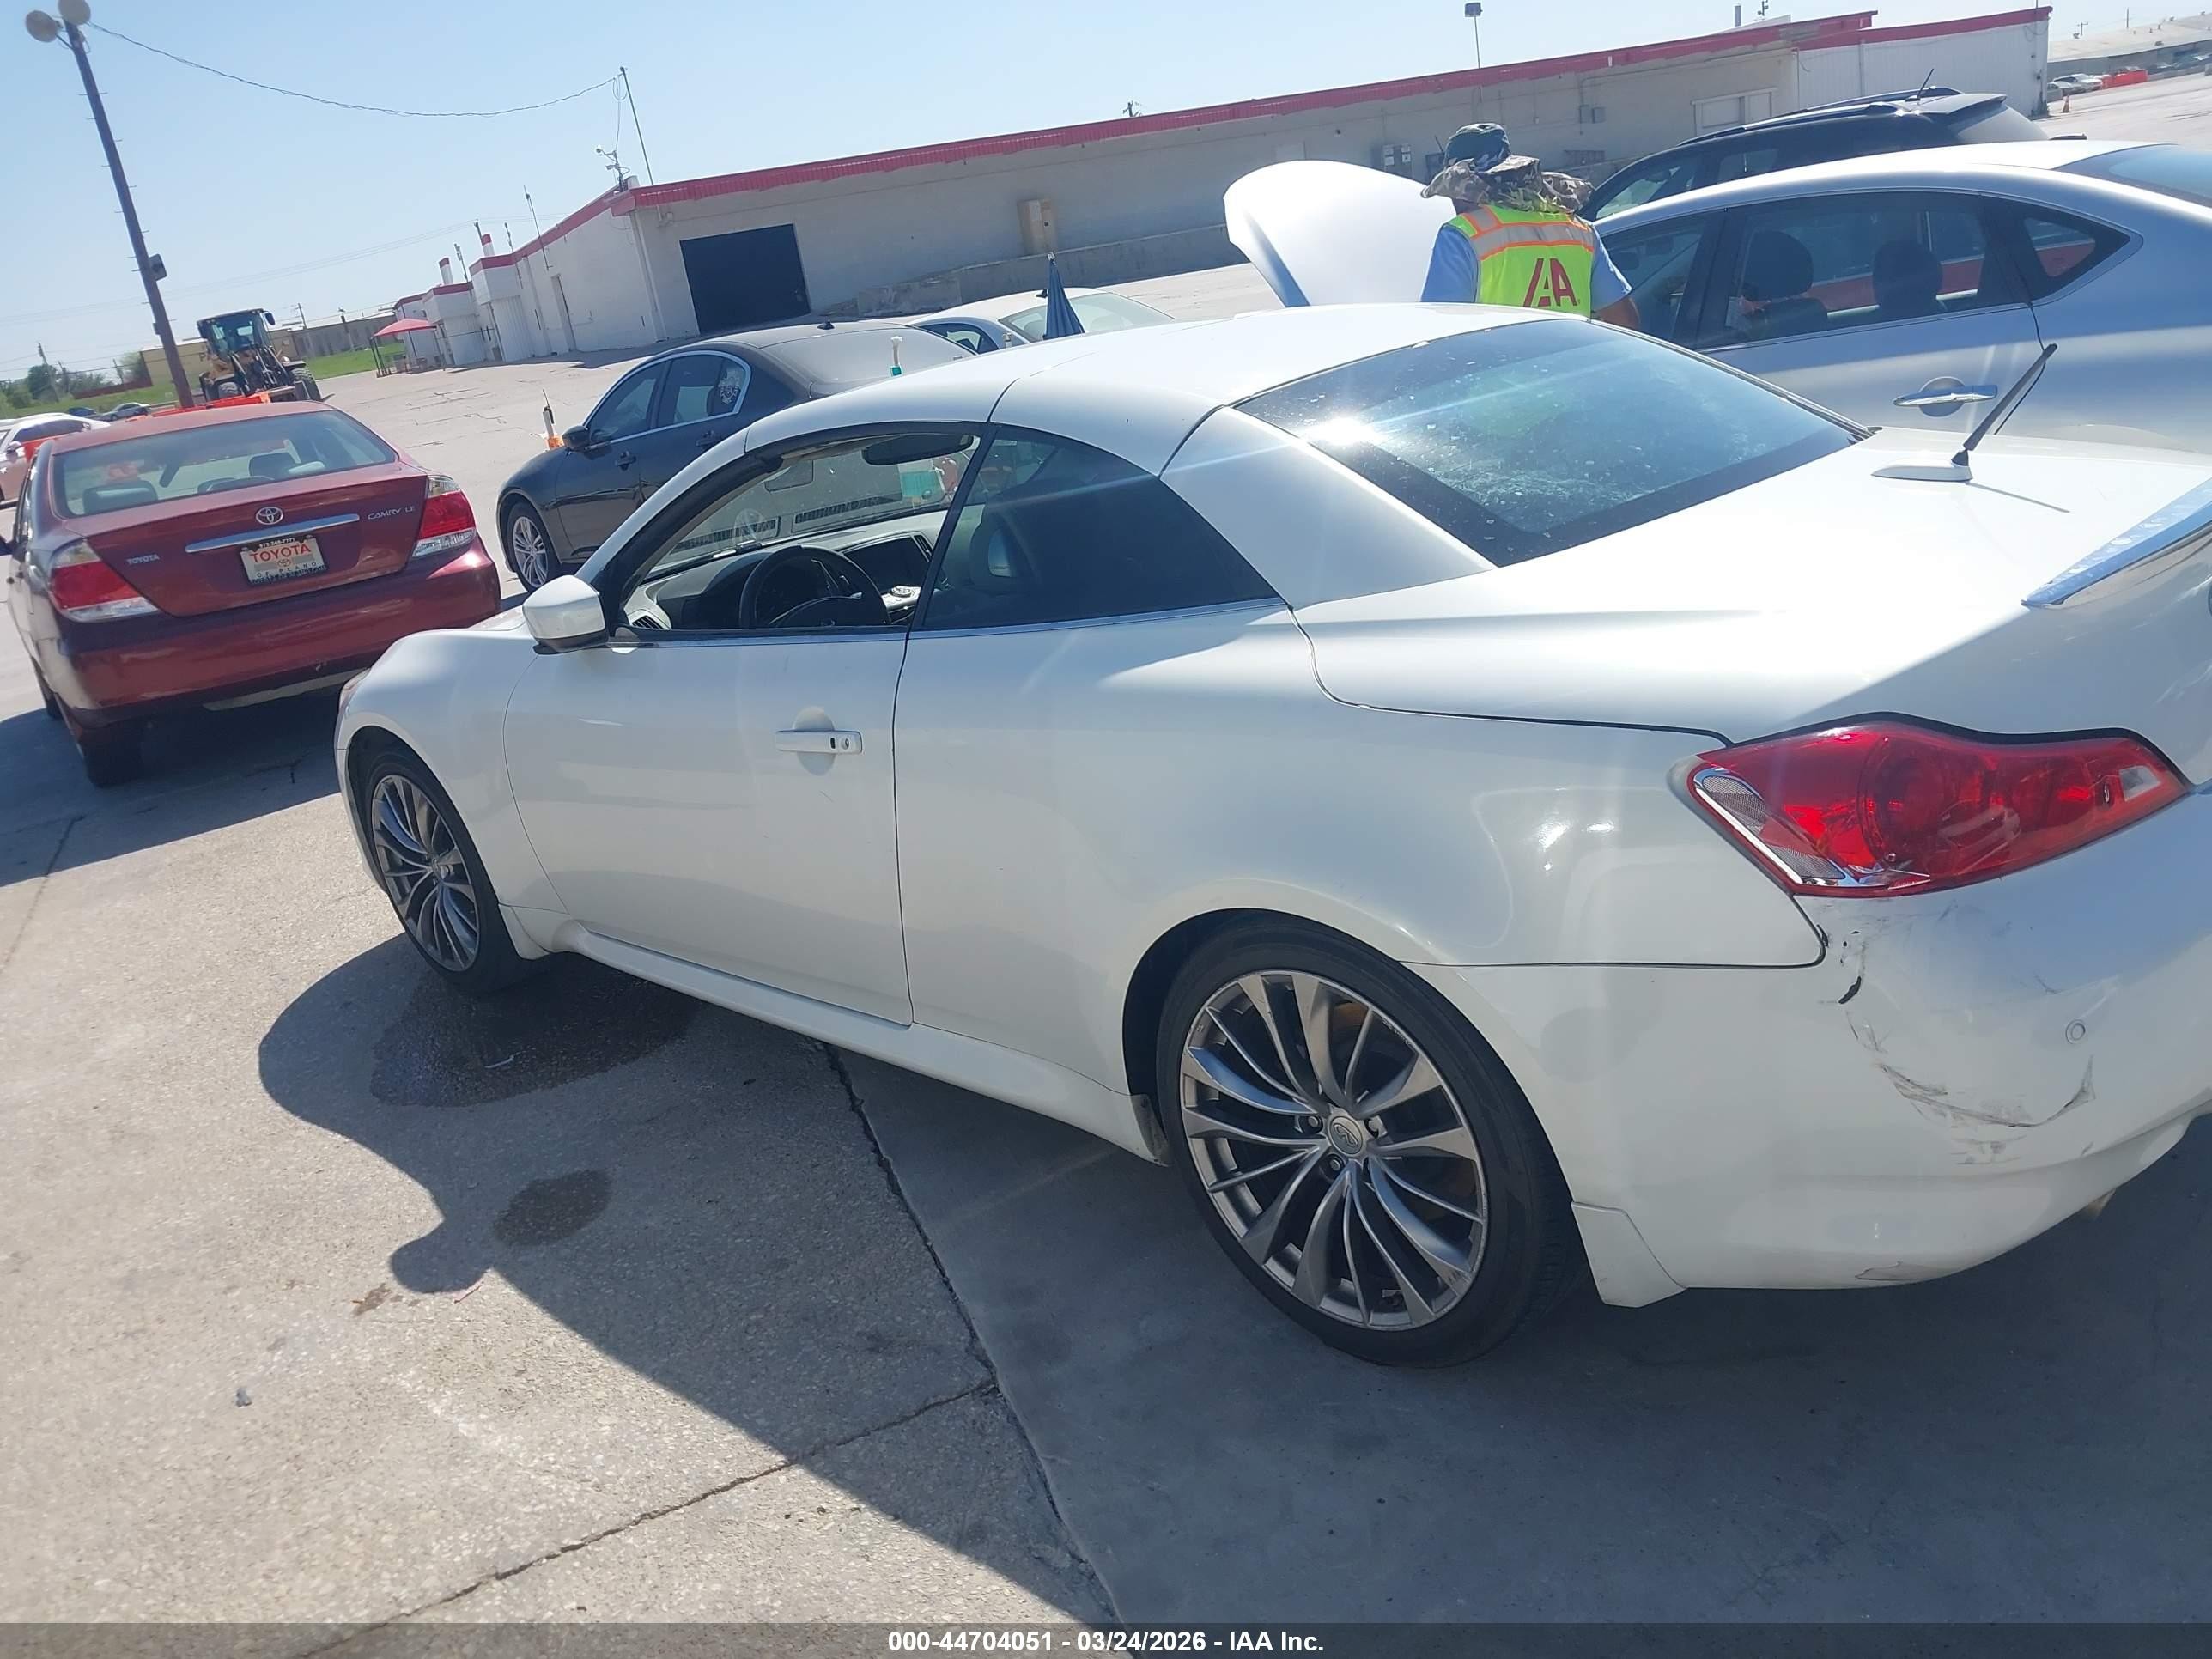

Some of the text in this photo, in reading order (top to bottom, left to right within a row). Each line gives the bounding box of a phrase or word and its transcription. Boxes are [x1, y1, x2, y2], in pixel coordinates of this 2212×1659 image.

[368, 508, 402, 520] CAMRY
[249, 543, 311, 563] TOYOTA
[126, 554, 160, 565] TOYOTA
[279, 562, 317, 572] PLANO
